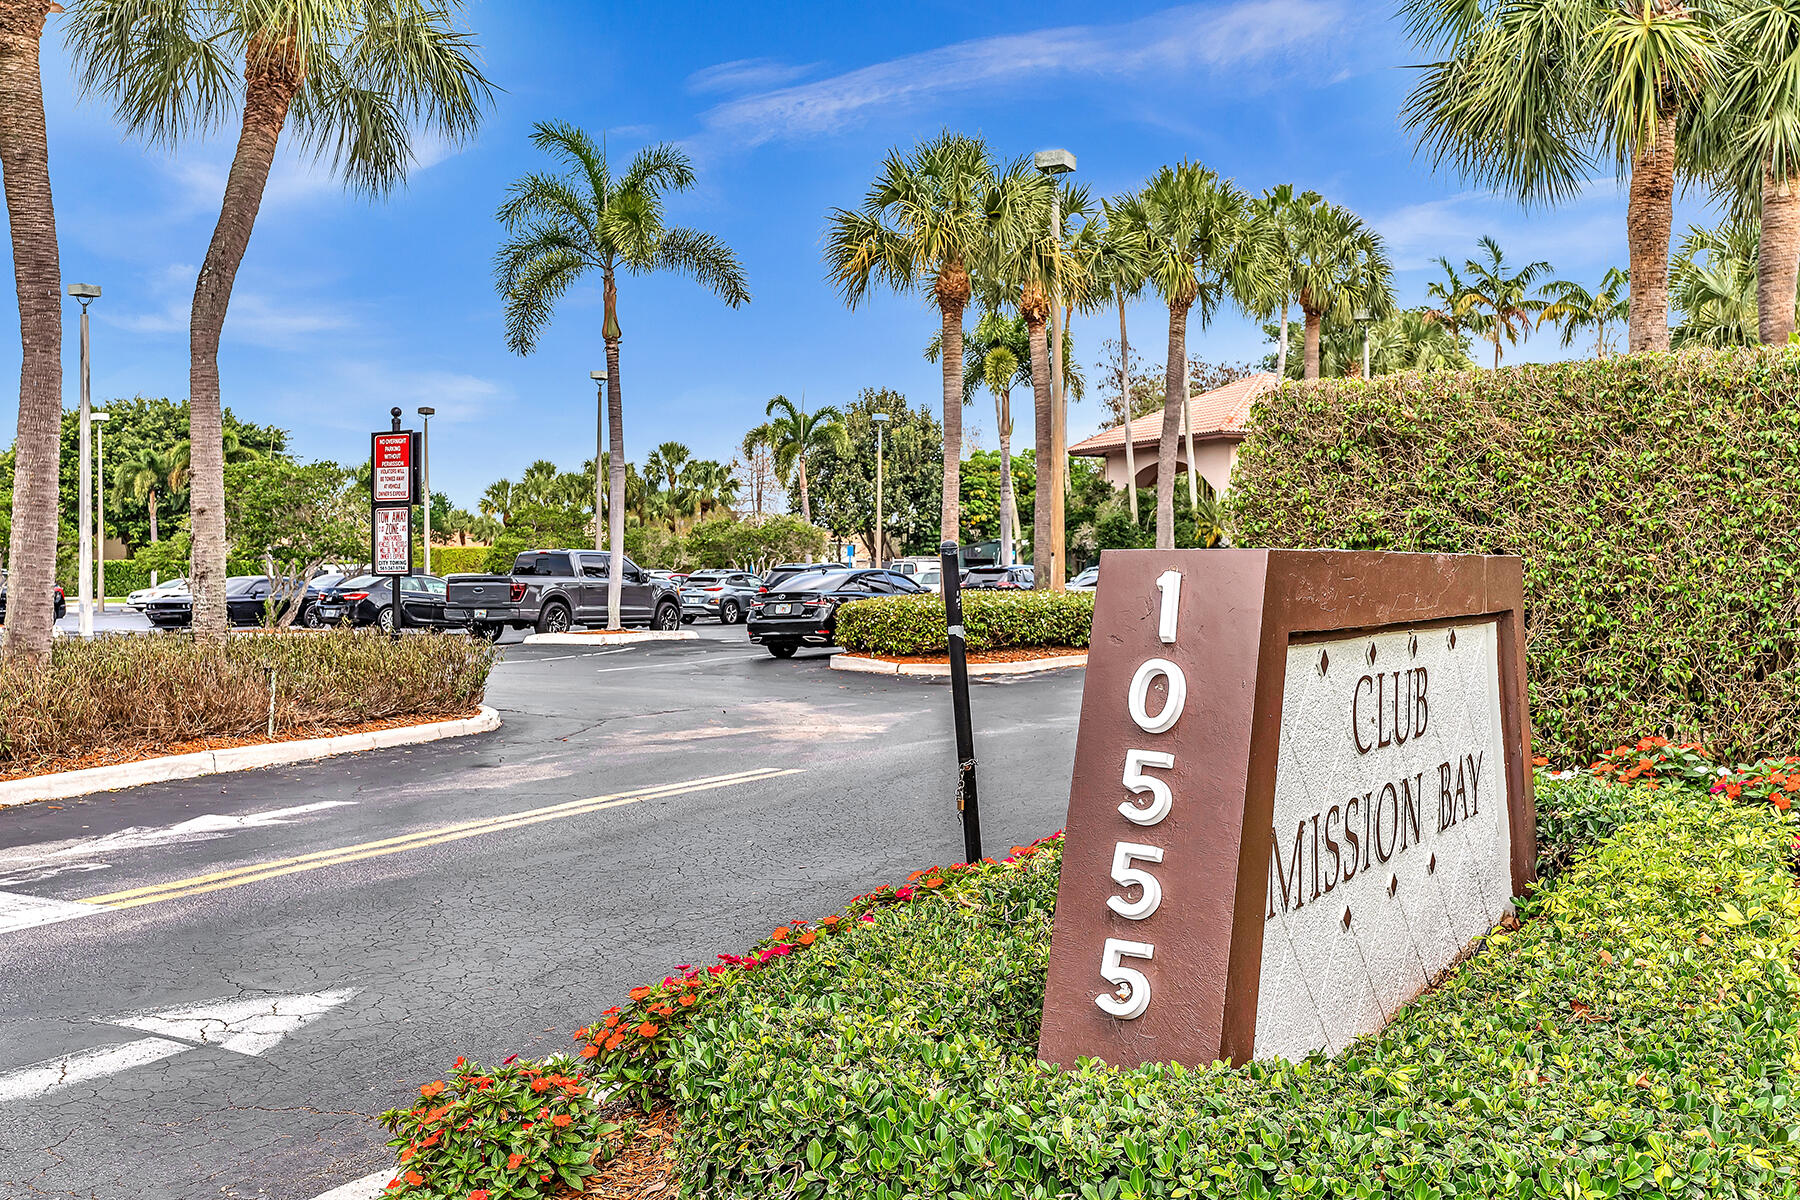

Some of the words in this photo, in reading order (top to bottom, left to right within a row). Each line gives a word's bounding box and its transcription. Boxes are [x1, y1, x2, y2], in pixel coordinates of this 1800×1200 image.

[378, 512, 389, 523] TOW
[392, 511, 407, 522] AWAY
[386, 523, 399, 535] ZONE
[1353, 666, 1428, 754] CLUB
[1094, 570, 1187, 1020] 10555
[1266, 773, 1422, 920] MISSION
[1437, 750, 1483, 833] BAY
